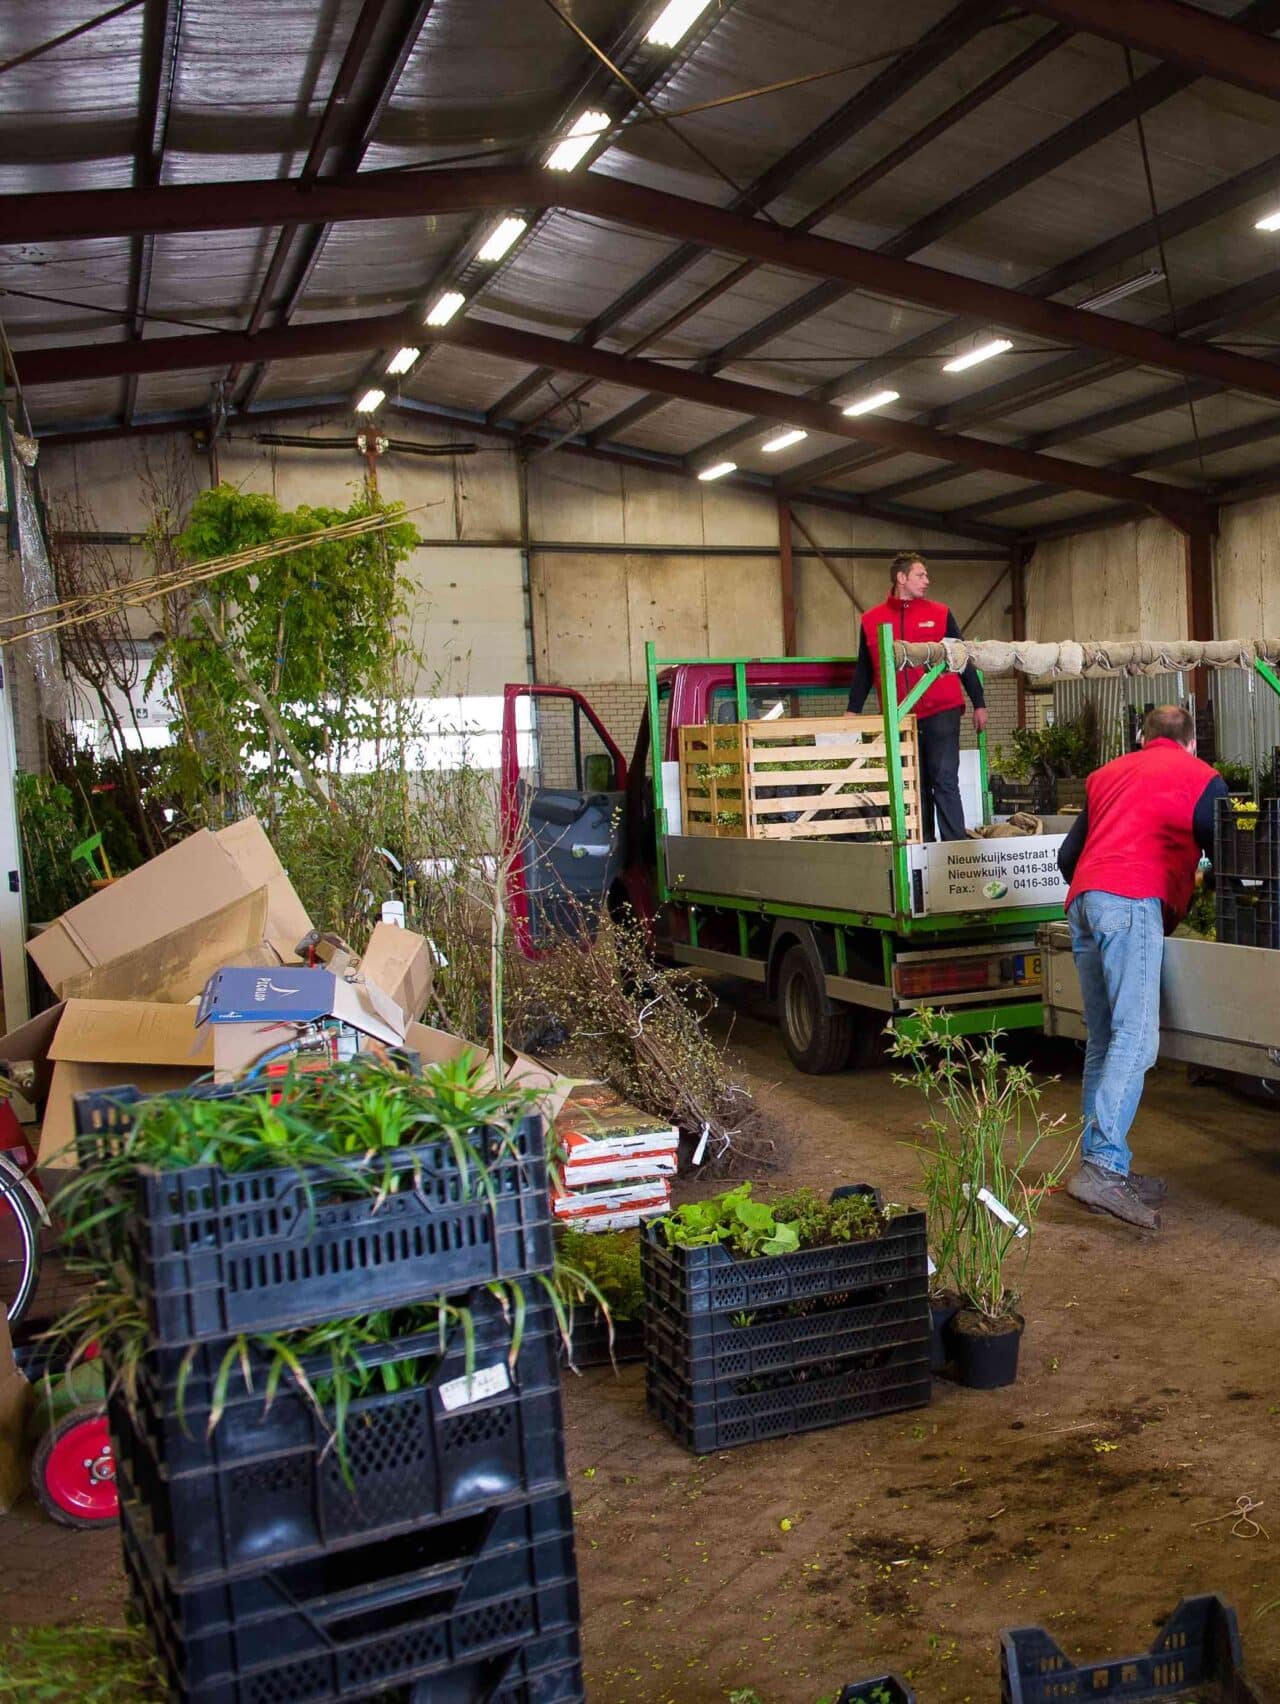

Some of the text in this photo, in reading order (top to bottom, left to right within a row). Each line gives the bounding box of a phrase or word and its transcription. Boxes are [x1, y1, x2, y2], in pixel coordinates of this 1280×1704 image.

[947, 849, 1048, 865] Nieuwkuijksestraat
[948, 863, 1059, 879] Nieuwkuijk 0416-380
[949, 884, 975, 895] Fax.:
[1013, 877, 1060, 889] 0416-380
